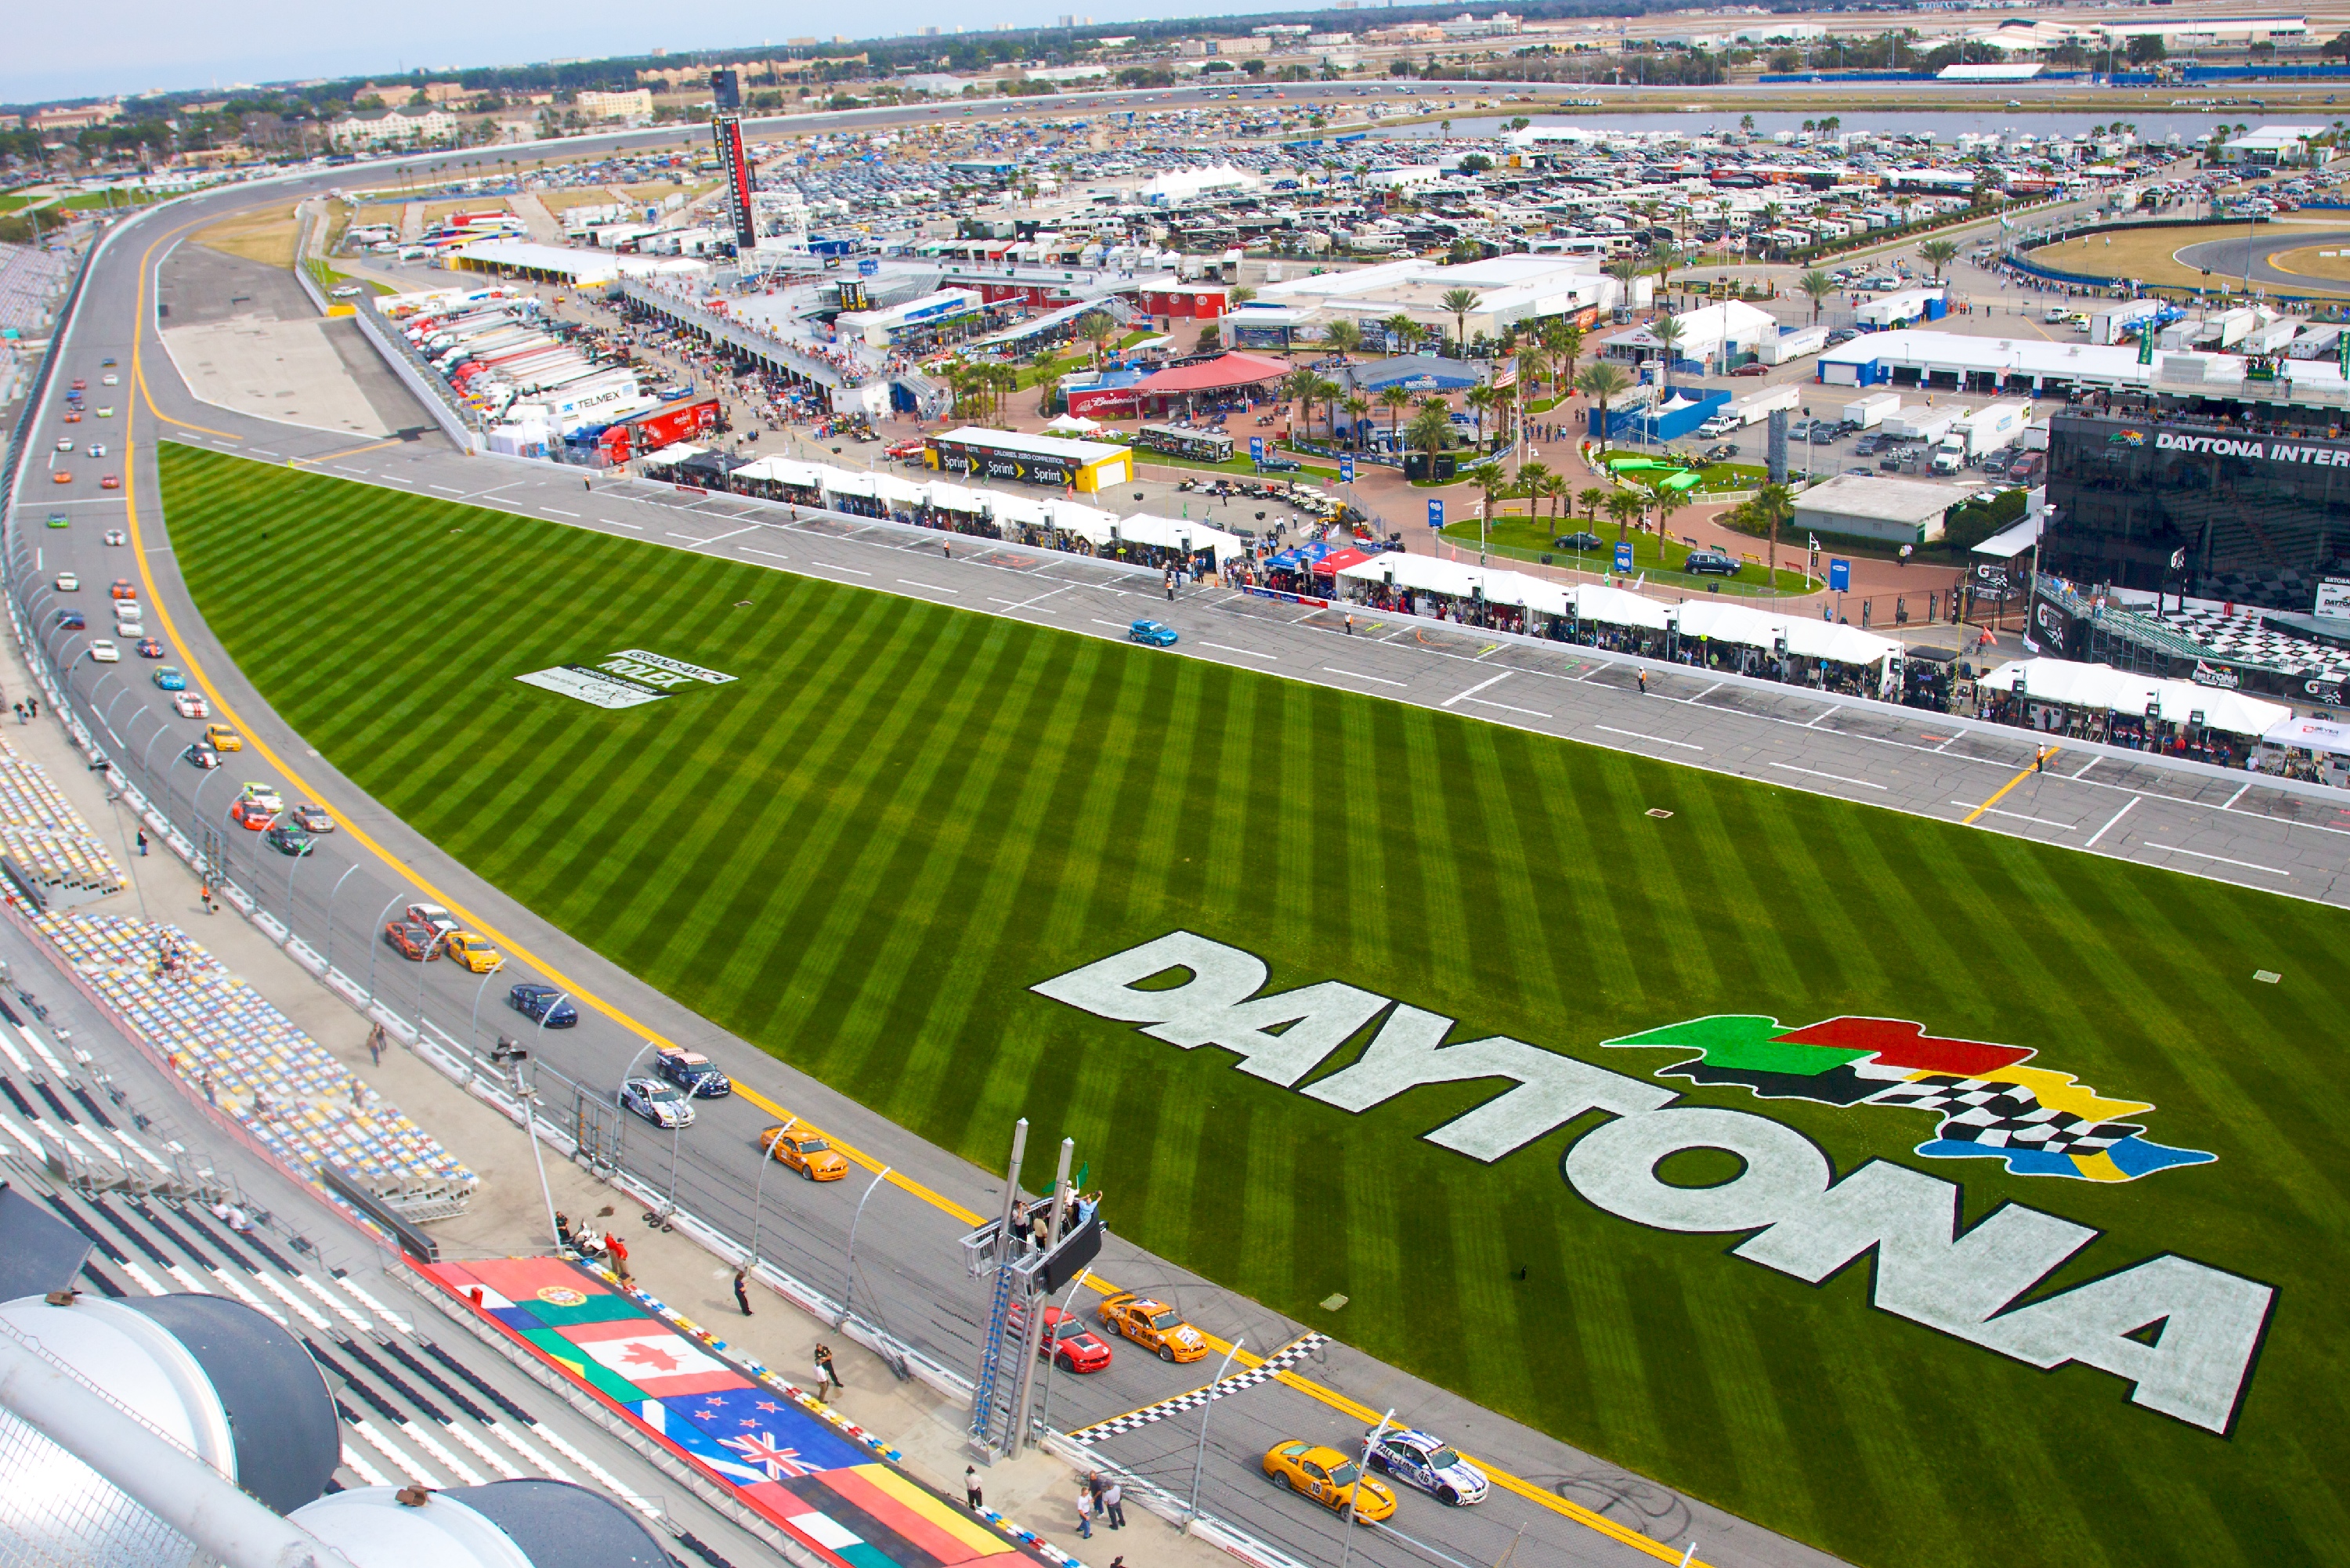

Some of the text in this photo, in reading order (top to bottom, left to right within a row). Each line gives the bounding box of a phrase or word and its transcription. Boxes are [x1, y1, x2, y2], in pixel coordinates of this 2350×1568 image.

[460, 396, 493, 409] SUNOCO
[577, 390, 620, 410] TELMEX
[2156, 433, 2350, 468] DAYTONA INTER
[944, 455, 968, 470] Sprint
[988, 461, 1014, 475] Sprint
[1034, 468, 1061, 482] Sprint
[596, 659, 693, 688] ROLEX
[1029, 930, 2276, 1435] DAYTONA
[1419, 1470, 1430, 1483] 46
